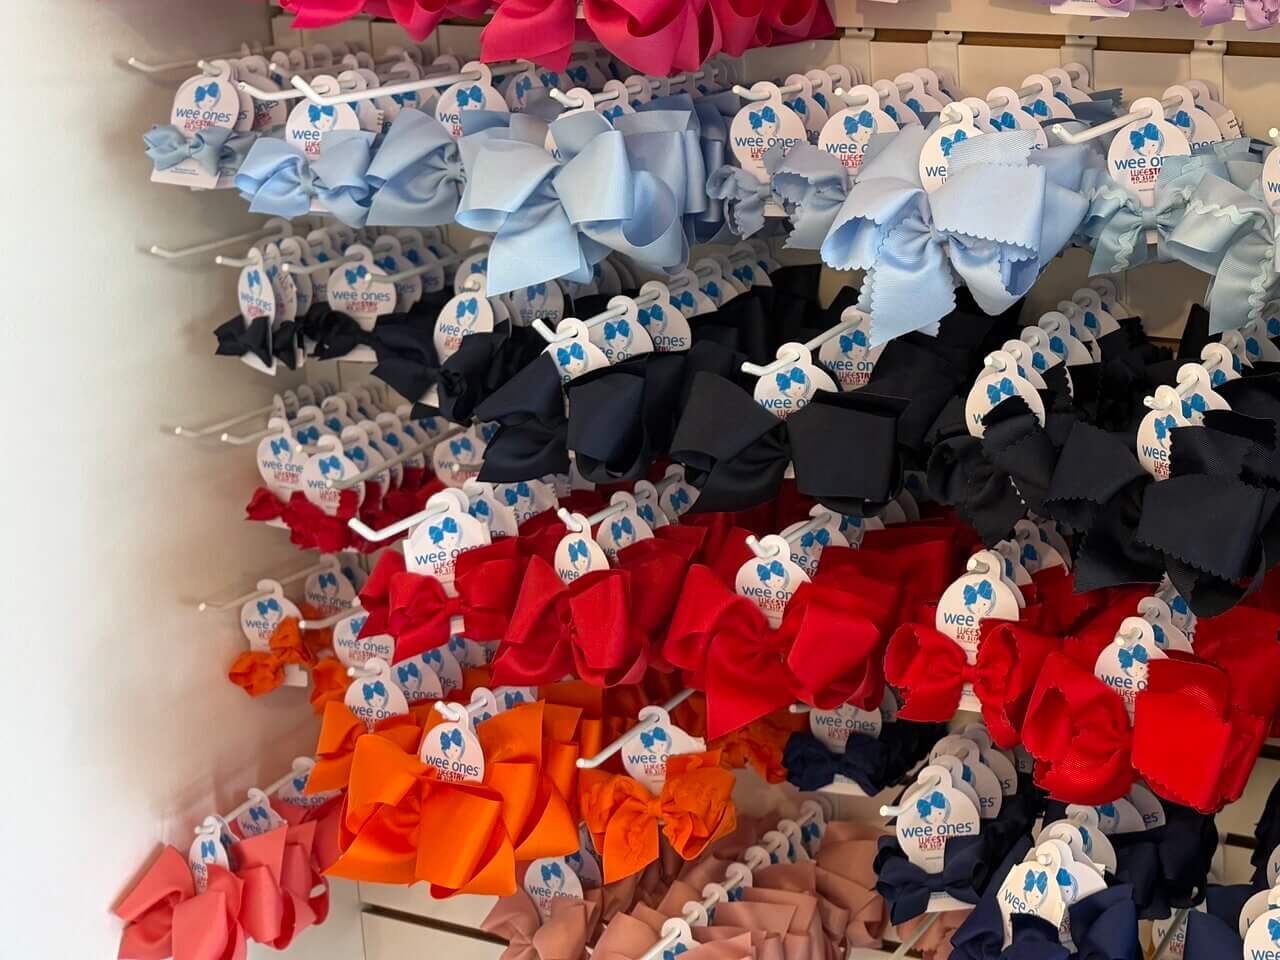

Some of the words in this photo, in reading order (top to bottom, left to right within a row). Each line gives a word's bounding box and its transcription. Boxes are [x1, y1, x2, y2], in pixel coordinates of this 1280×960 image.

[176, 107, 200, 119] wee
[202, 110, 232, 122] ones
[293, 129, 320, 140] wee
[735, 137, 764, 147] wee
[826, 143, 857, 153] wee
[1115, 157, 1146, 170] wee
[333, 291, 360, 301] wee
[362, 291, 391, 302] ones
[439, 323, 460, 336] wee
[825, 360, 853, 371] wee
[761, 398, 792, 409] wee
[1142, 445, 1167, 461] wee
[262, 459, 283, 470] wee
[415, 550, 446, 566] wee
[559, 568, 580, 580] wee
[742, 585, 771, 598] wee
[246, 619, 270, 629] wee
[944, 612, 974, 627] wee
[338, 638, 360, 650] wee
[363, 642, 391, 655] ones
[1101, 673, 1132, 688] wee
[816, 715, 841, 727] wee
[845, 720, 876, 732] ones
[628, 753, 656, 764] wee
[426, 755, 449, 769] wee
[452, 762, 480, 777] ones
[902, 824, 932, 838] wee
[937, 823, 972, 836] ones
[529, 884, 551, 897] wee
[1004, 888, 1026, 913] wee
